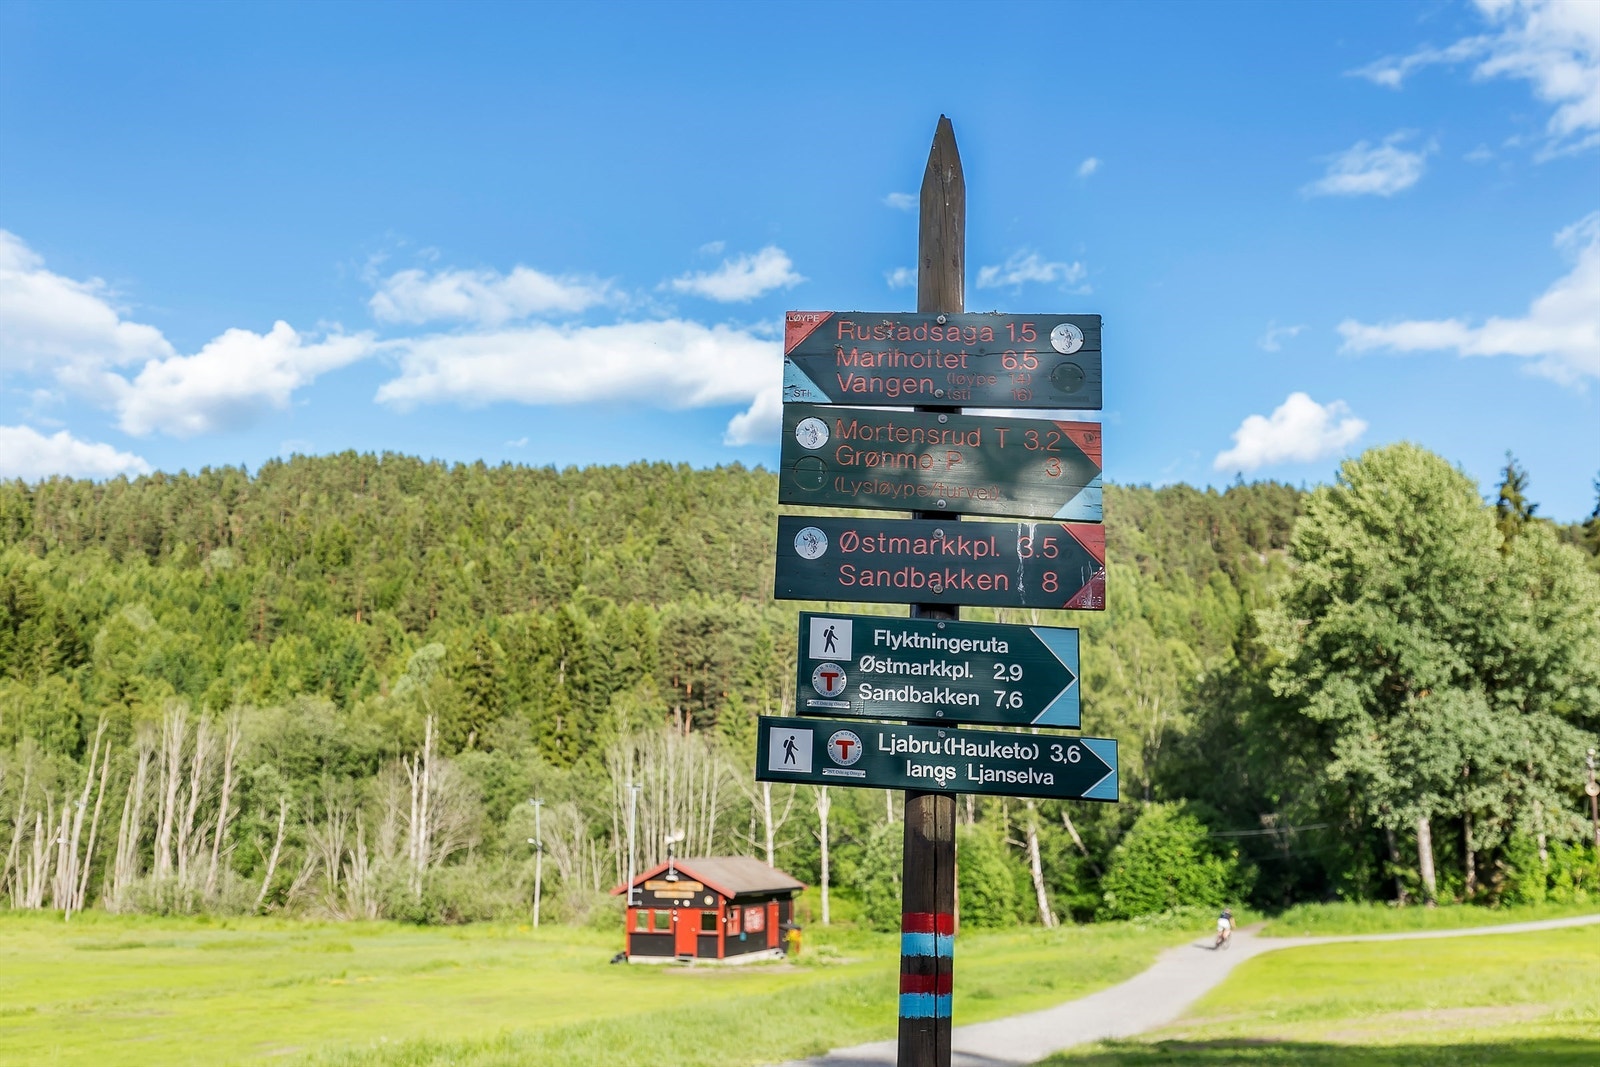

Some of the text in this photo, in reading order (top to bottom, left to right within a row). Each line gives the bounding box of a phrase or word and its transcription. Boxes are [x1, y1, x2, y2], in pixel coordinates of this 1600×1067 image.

[788, 314, 820, 323] LØYPE
[837, 320, 1038, 346] Rustadsaga 1,5
[1001, 348, 1039, 371] 6,5
[836, 372, 935, 398] Vangen
[1009, 372, 1032, 386] 14)
[1011, 388, 1033, 402] 16)
[834, 417, 981, 447] Mortensrud
[994, 428, 1010, 449] T
[835, 444, 1062, 479] Grønmo P 3
[838, 529, 1001, 561] Østmarkkpl.
[838, 564, 1059, 594] Sandbakken 8
[873, 629, 1009, 655] Flyktningeruta
[859, 654, 1023, 683] Østmarkkpl. 2,9
[858, 683, 1023, 710] Sandbakken 7,6
[1050, 744, 1081, 764] 3,6
[906, 760, 1054, 786] langs Ljanselva
